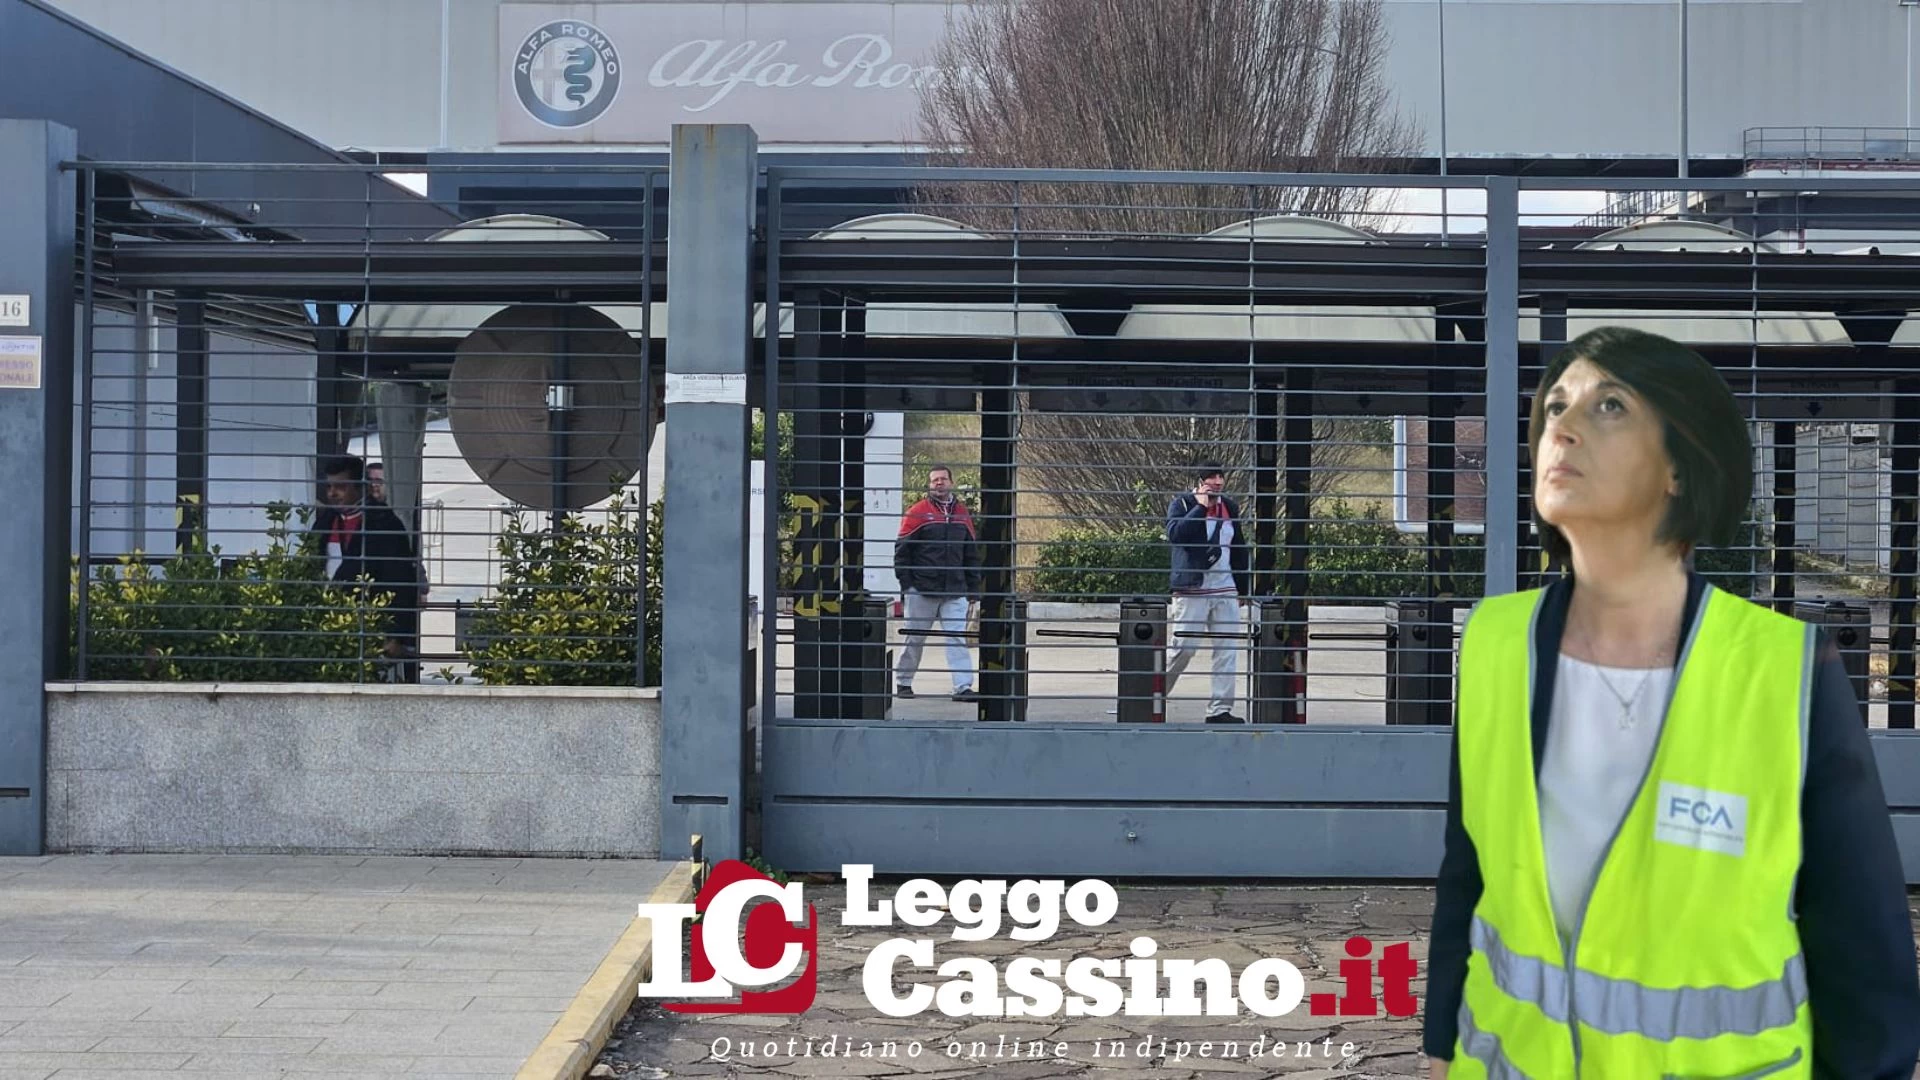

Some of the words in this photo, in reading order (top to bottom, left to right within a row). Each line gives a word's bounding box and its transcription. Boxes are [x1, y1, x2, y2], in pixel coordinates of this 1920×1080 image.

[518, 30, 552, 74] ALFA
[561, 24, 617, 75] ROMEO
[648, 39, 811, 112] Alfa
[811, 34, 988, 88] Rom
[2, 300, 21, 317] 16
[1669, 796, 1734, 830] FCA
